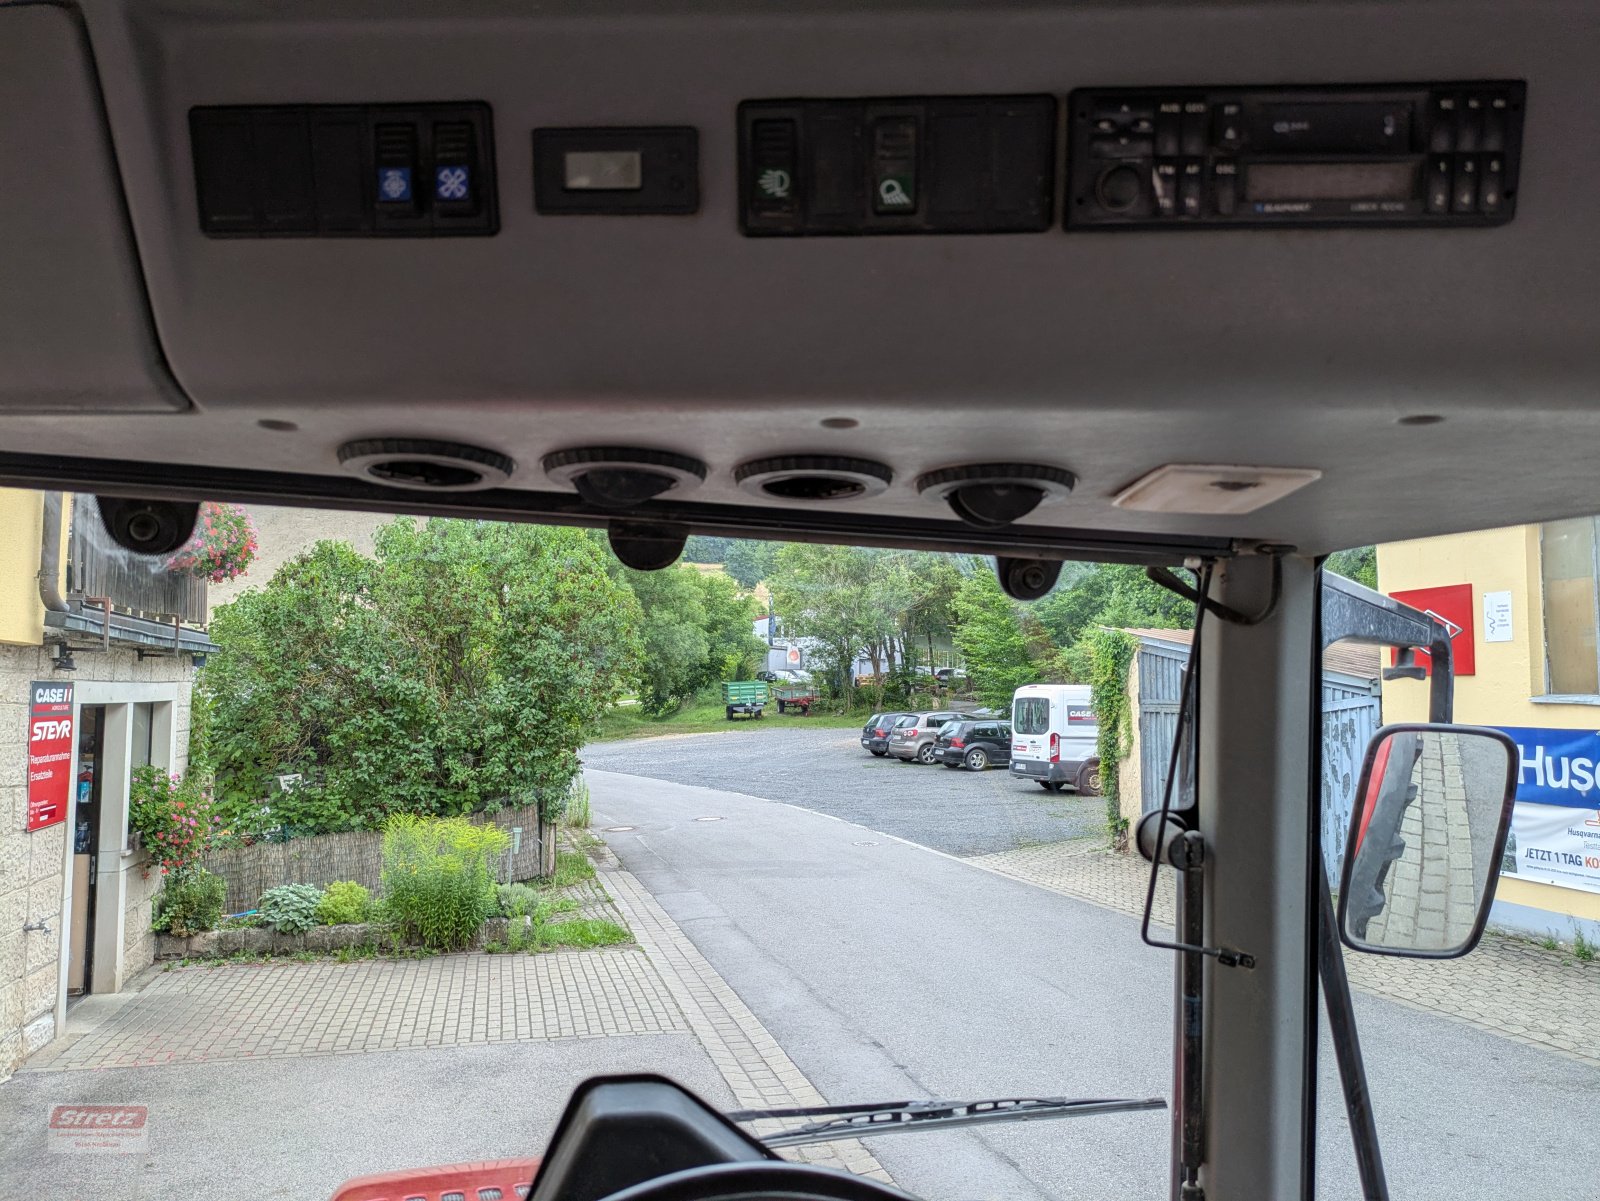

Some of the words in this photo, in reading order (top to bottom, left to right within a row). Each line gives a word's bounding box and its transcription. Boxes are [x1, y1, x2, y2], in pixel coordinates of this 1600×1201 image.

[35, 687, 63, 704] CASE
[31, 719, 71, 742] STEYR
[30, 769, 53, 782] Ersatzteile
[1517, 744, 1600, 791] Hus
[1525, 847, 1552, 861] JETZT
[1554, 852, 1560, 863] 1
[1561, 853, 1583, 867] TAG
[1584, 856, 1600, 869] KO
